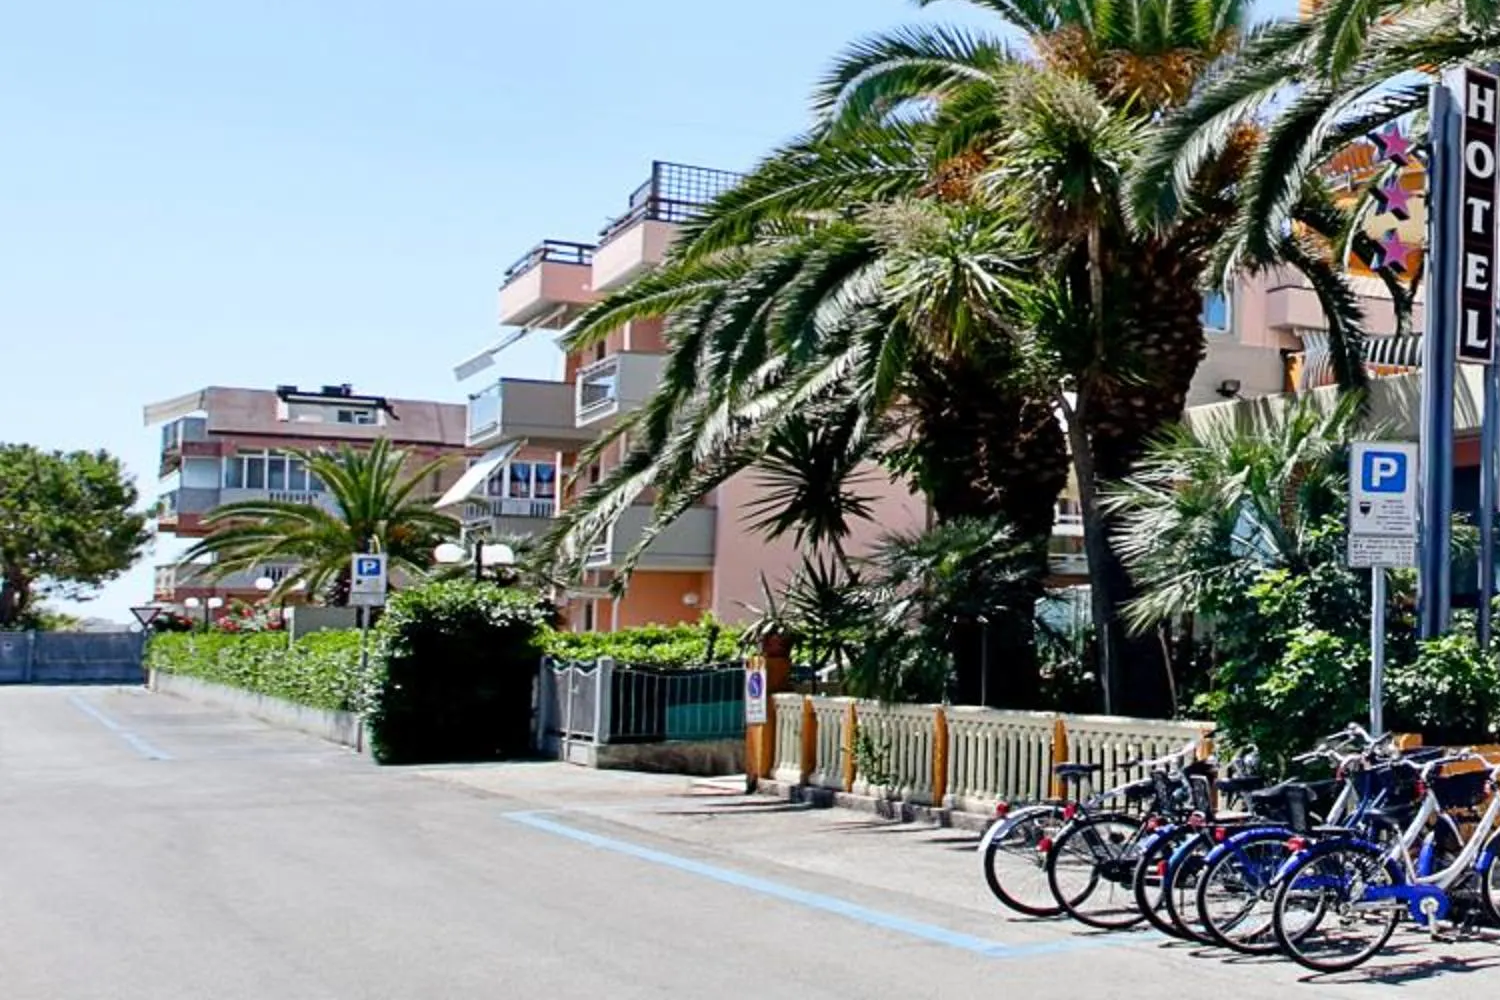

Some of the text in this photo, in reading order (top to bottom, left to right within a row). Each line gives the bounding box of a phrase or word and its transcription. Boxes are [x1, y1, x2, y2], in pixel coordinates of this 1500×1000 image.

[1465, 83, 1495, 349] HOTEL
[1371, 457, 1398, 488] P
[362, 561, 376, 575] P
